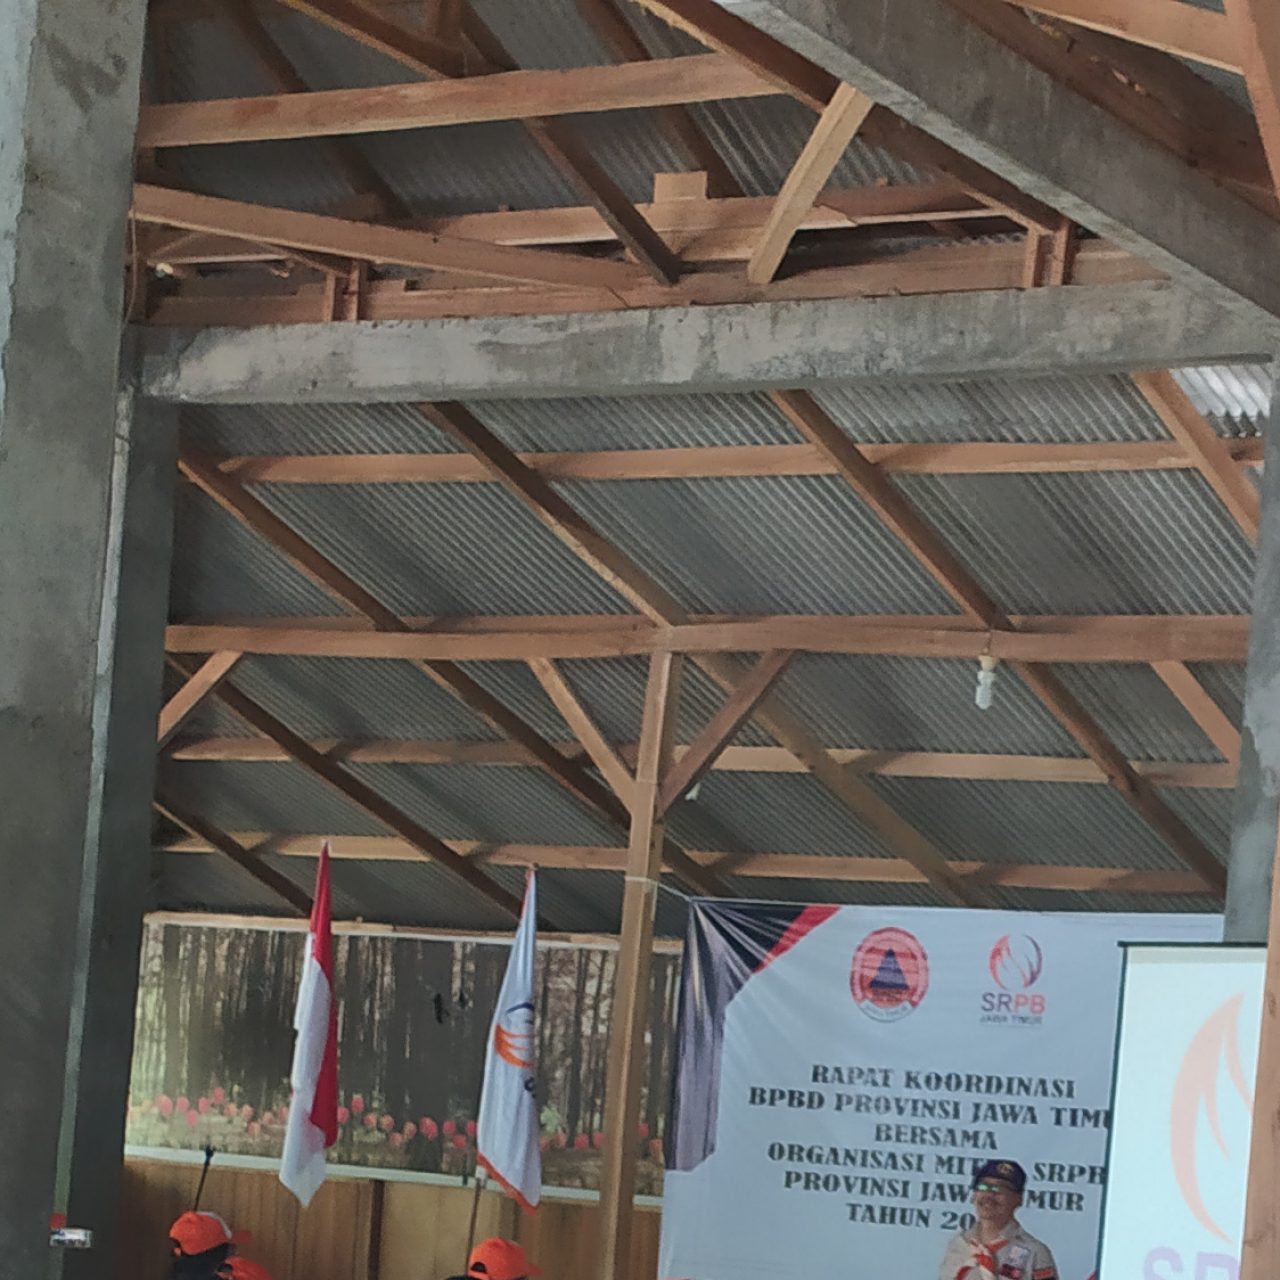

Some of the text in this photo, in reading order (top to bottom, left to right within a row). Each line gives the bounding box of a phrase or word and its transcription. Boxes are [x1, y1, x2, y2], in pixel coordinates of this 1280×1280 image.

[980, 991, 1046, 1016] SRPB
[811, 1063, 1076, 1100] RAPAT KOORDINASI
[749, 1085, 825, 1111] BPBD
[833, 1092, 961, 1120] PROVINSI
[970, 1101, 1039, 1126] JAWA
[874, 1122, 998, 1150] BERSAMA
[767, 1141, 926, 1172] ORGANISASI
[784, 1170, 910, 1199] PROVINSI
[920, 1181, 973, 1203] JAW
[847, 1203, 931, 1228] TAHUN
